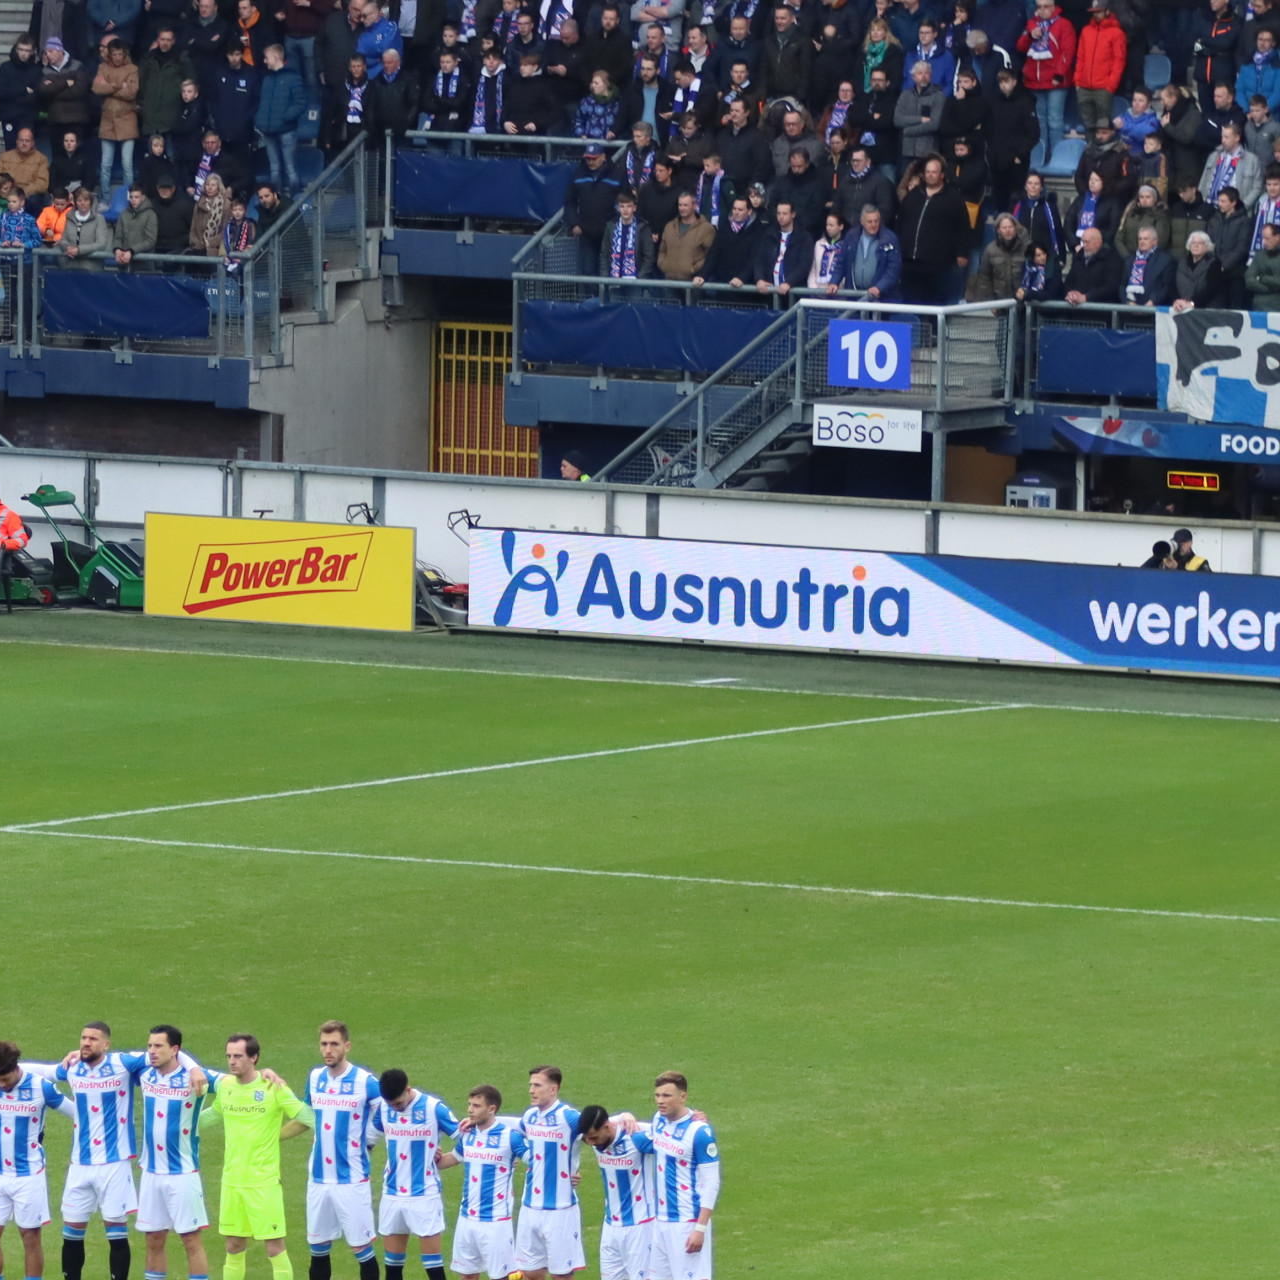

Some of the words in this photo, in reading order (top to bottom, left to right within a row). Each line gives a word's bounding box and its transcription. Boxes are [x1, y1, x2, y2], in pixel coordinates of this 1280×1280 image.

[841, 329, 898, 382] 10
[887, 419, 899, 430] for
[199, 546, 358, 593] PowerBar
[576, 552, 910, 637] Ausnutria
[78, 1078, 121, 1089] Ausnutria
[316, 1098, 358, 1108] Ausnutria
[229, 1105, 266, 1114] Ausnutria
[389, 1127, 432, 1137] Ausnutria
